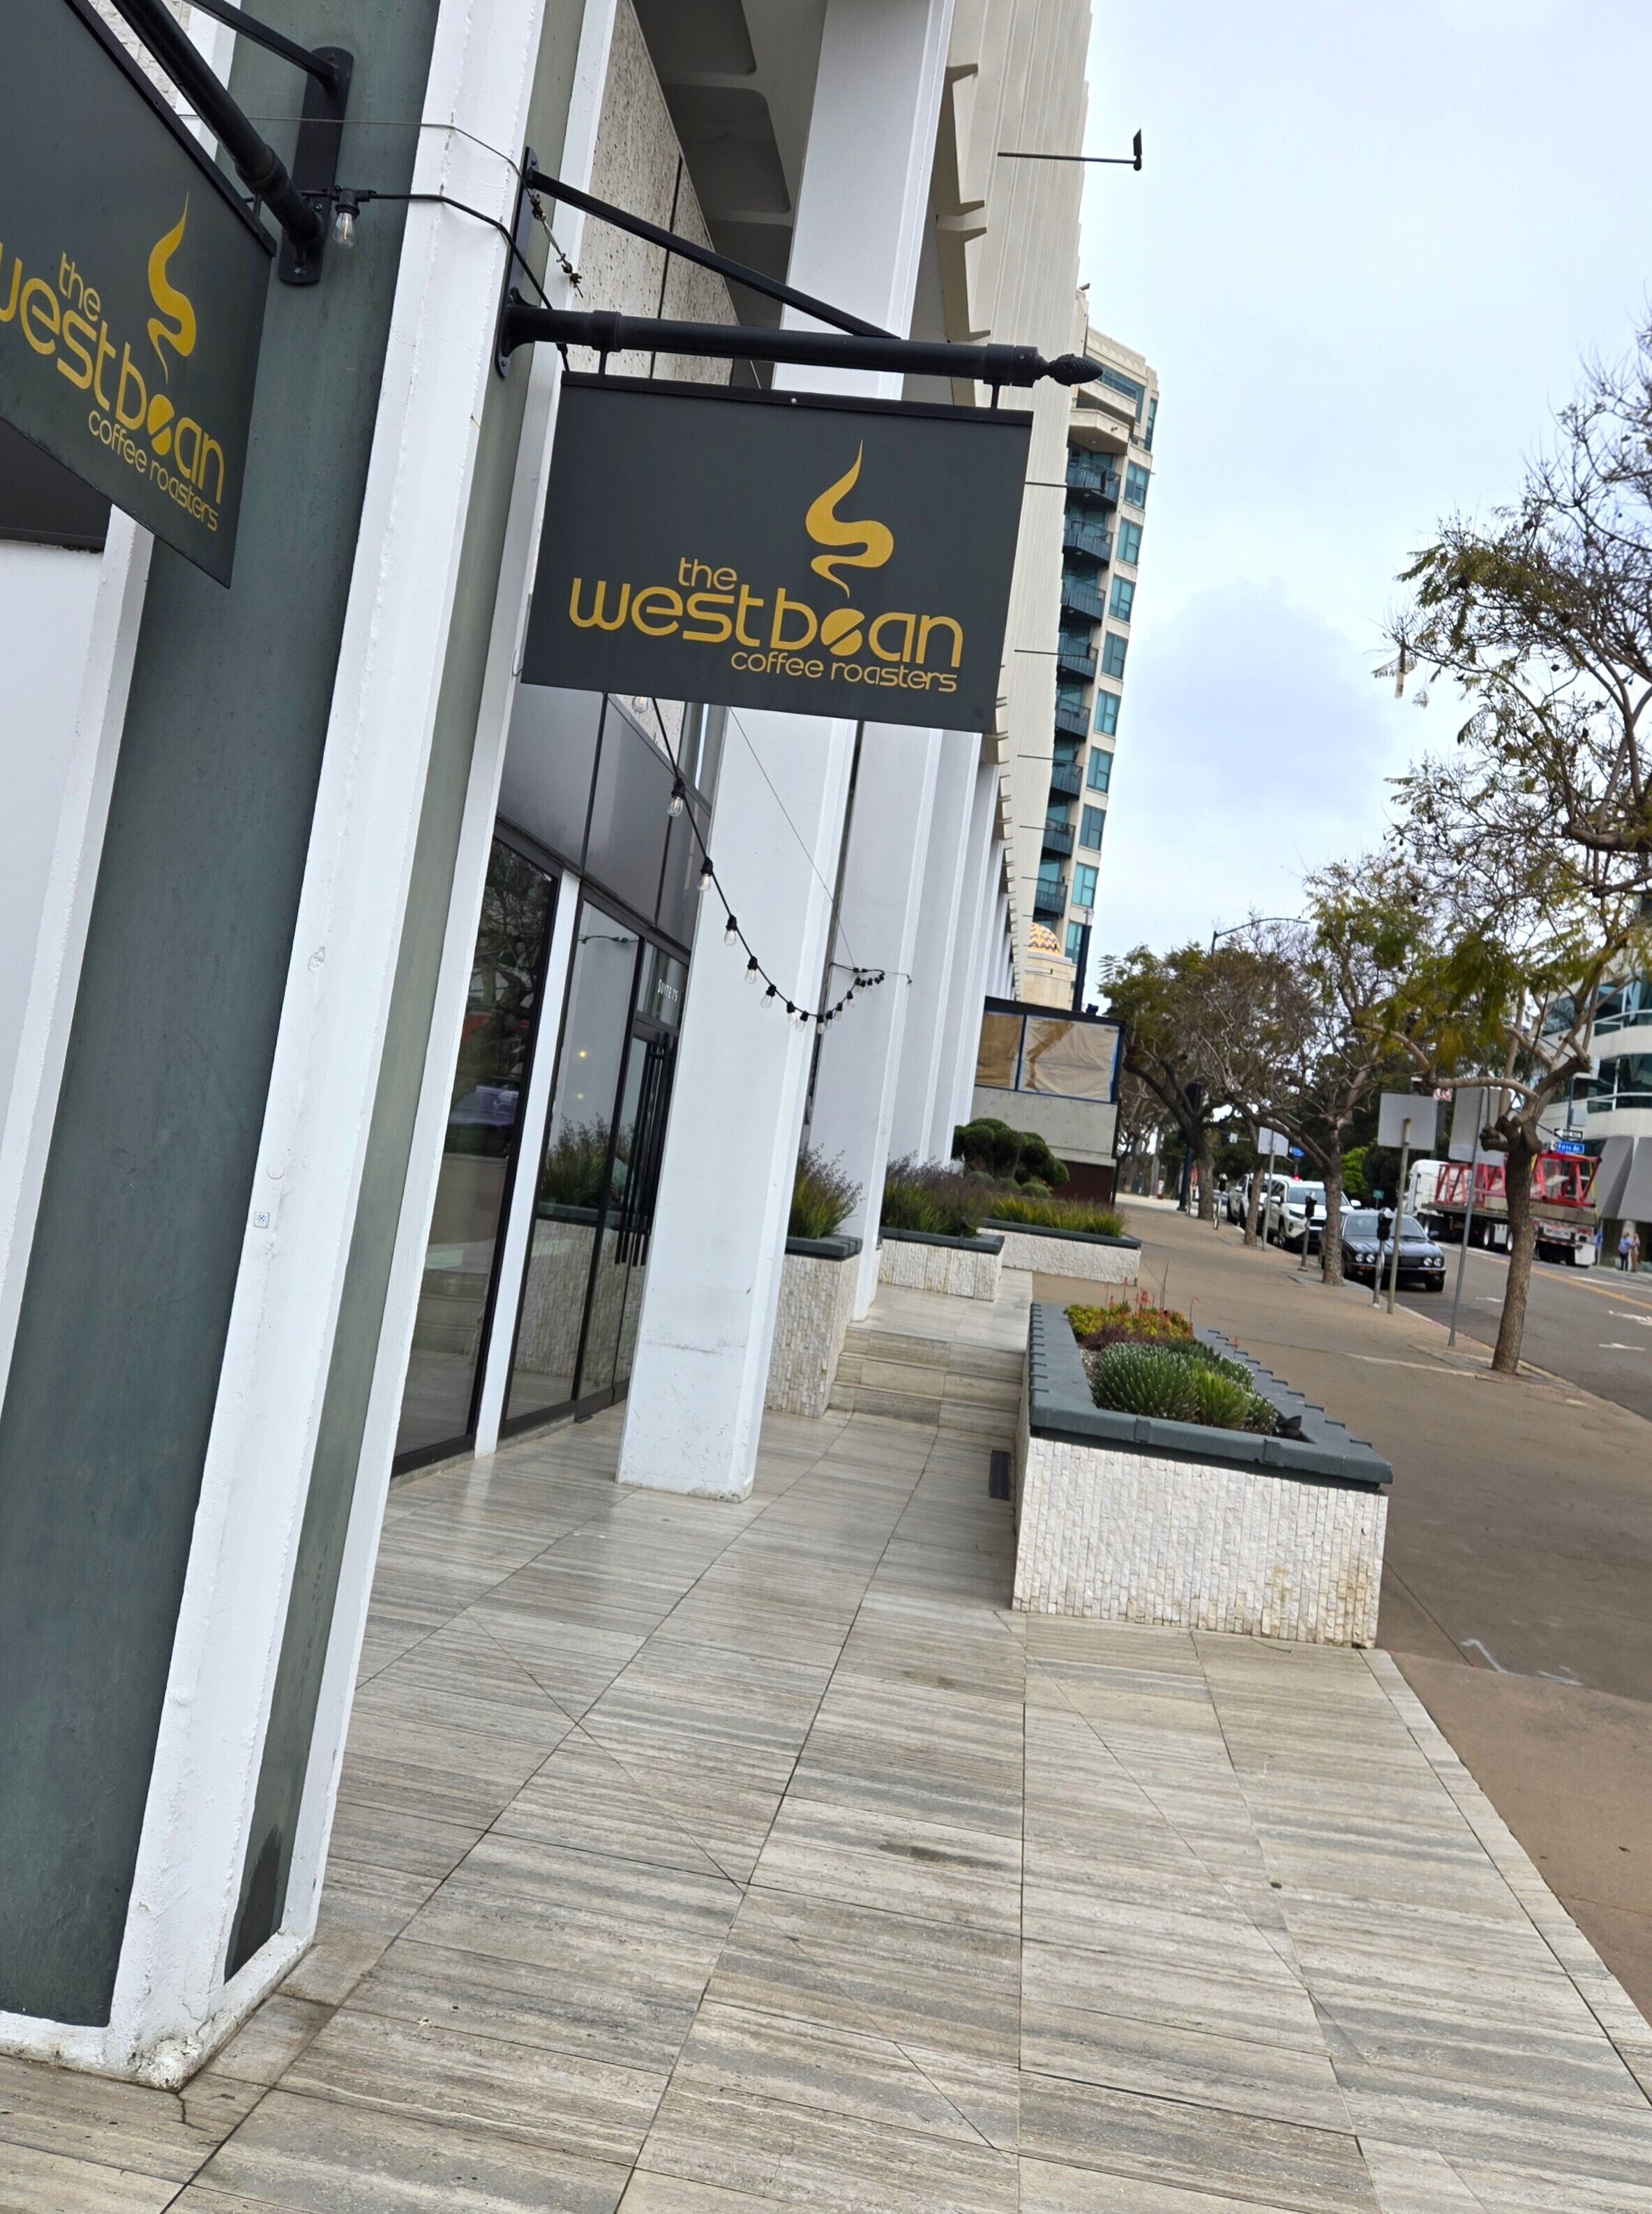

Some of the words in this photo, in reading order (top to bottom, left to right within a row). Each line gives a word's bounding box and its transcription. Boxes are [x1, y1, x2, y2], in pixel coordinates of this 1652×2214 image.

[59, 252, 101, 322] the
[88, 410, 147, 474] coffee
[149, 459, 218, 532] roasters
[678, 558, 737, 591] the
[730, 650, 824, 679] coffee
[829, 661, 958, 693] roasters
